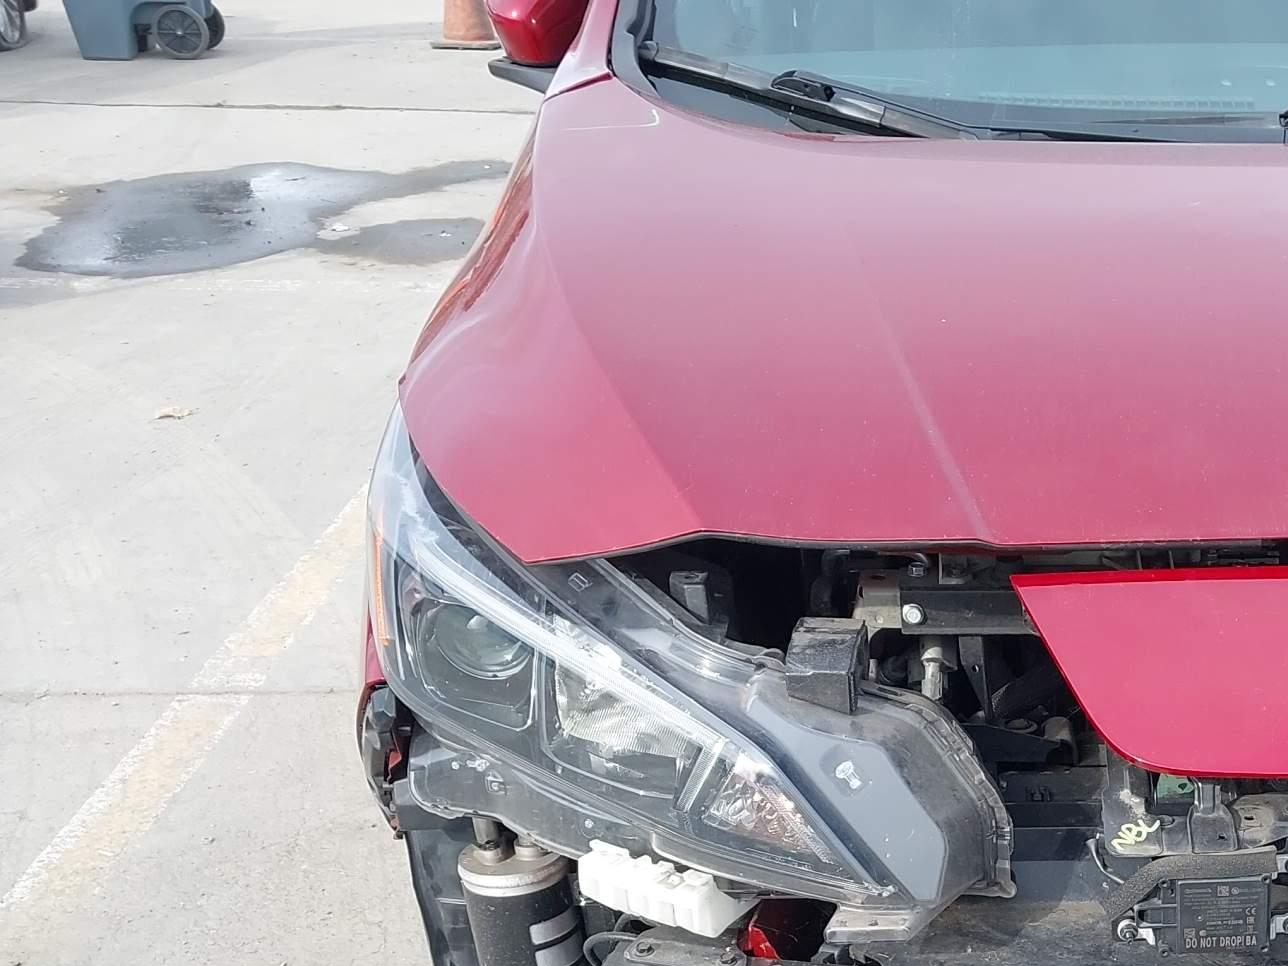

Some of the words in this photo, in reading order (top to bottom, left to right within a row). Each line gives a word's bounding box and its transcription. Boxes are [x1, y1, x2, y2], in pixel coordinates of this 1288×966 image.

[1185, 938, 1198, 949] DO
[1200, 936, 1217, 948] NOT
[1245, 935, 1257, 946] BA
